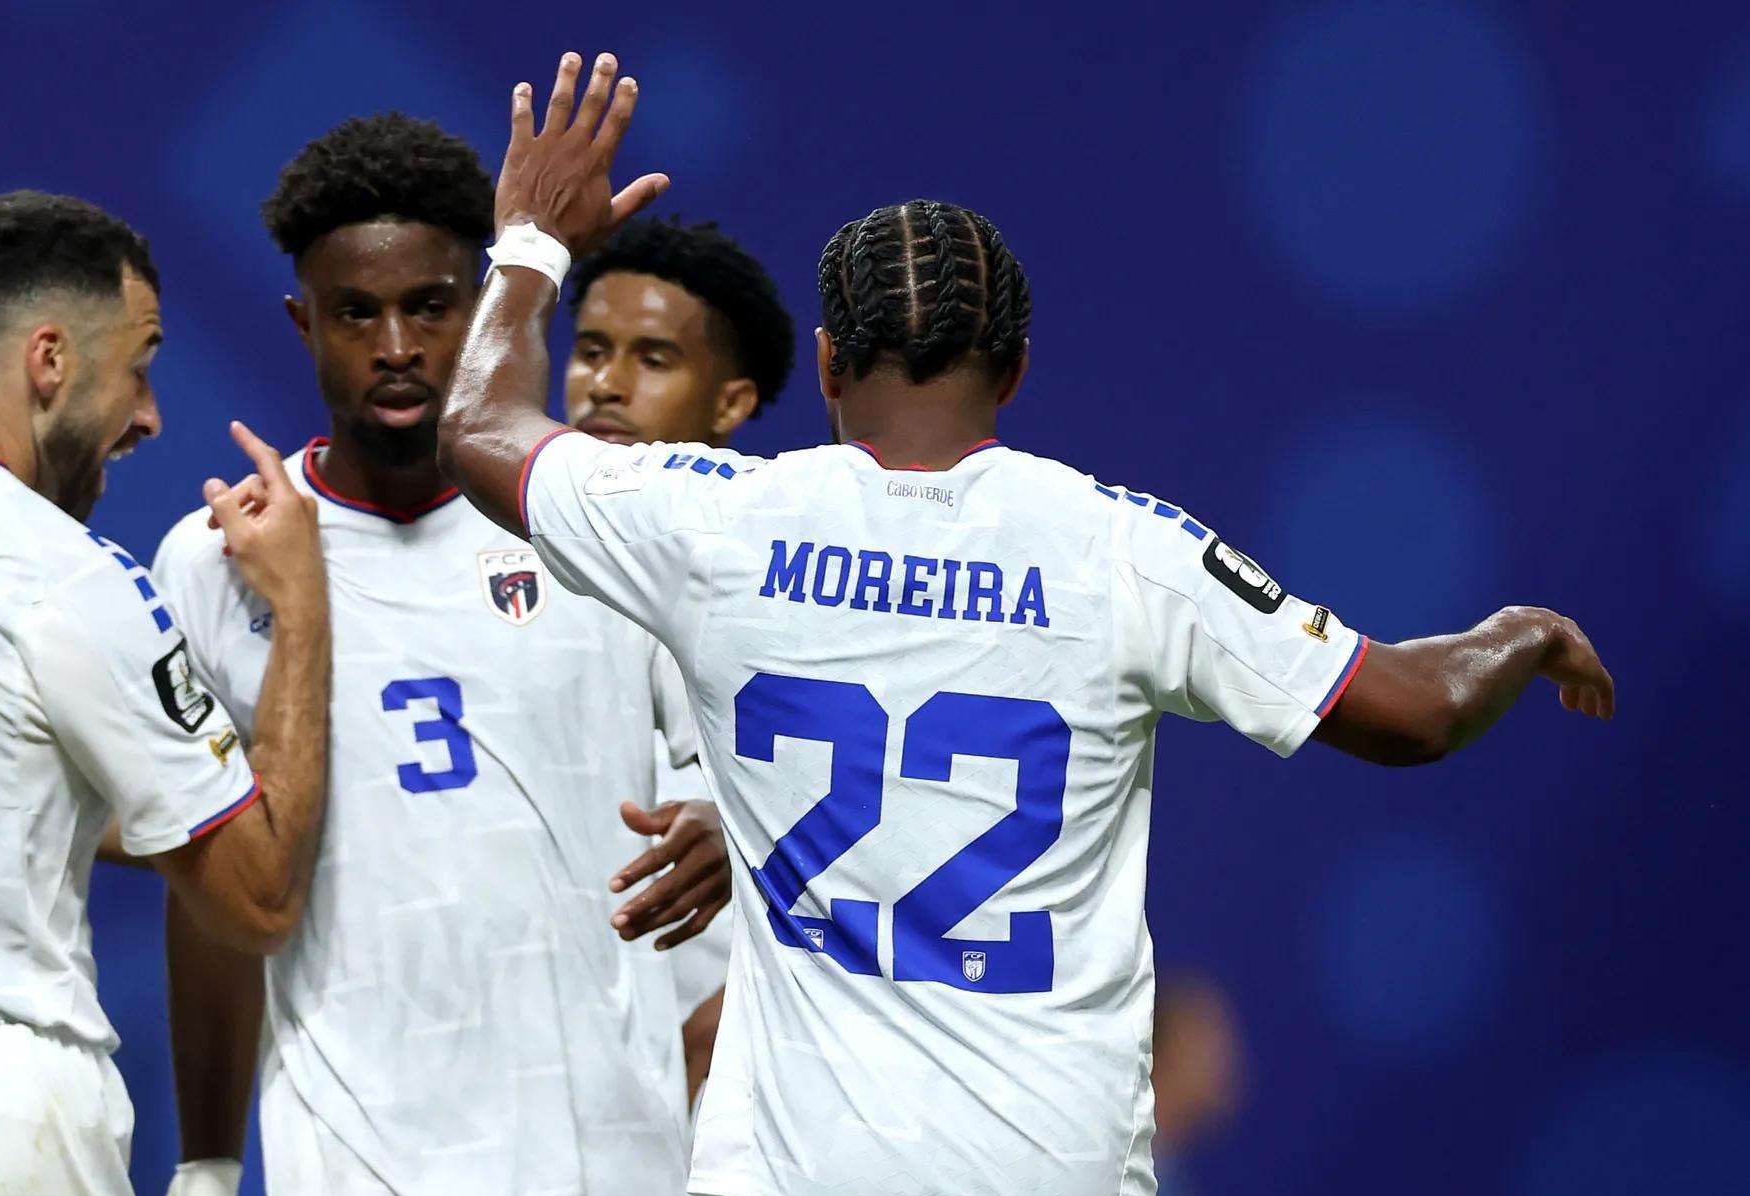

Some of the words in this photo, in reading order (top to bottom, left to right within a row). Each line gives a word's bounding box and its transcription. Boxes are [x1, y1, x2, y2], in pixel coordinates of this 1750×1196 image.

[759, 539, 1051, 628] MOREIRA
[381, 677, 478, 794] 3
[734, 672, 1072, 994] 22
